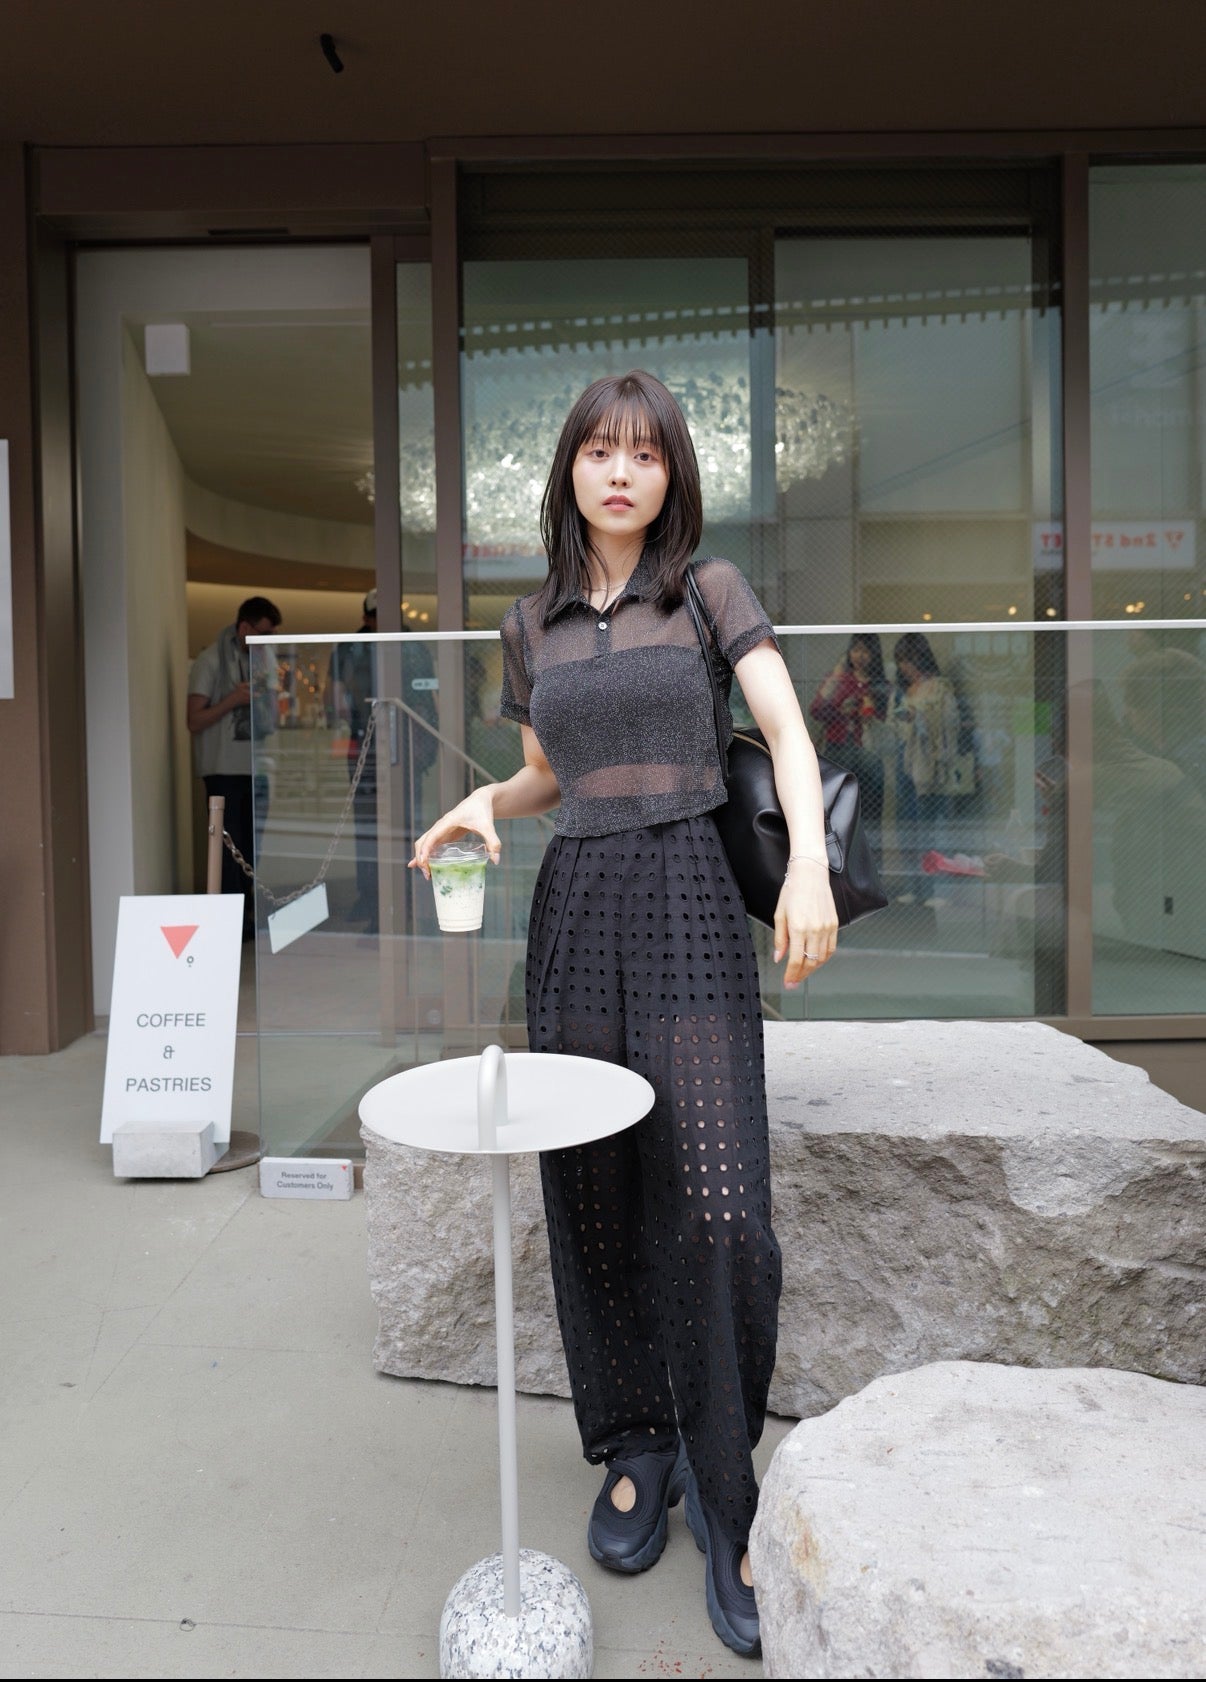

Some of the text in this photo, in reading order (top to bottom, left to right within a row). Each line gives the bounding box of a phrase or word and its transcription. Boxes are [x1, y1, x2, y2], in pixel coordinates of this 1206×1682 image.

[136, 1012, 206, 1027] COFFEE
[163, 1045, 175, 1059] &
[126, 1077, 212, 1092] PASTRIES
[281, 1171, 315, 1180] Reserved
[277, 1181, 333, 1191] Customers Only
